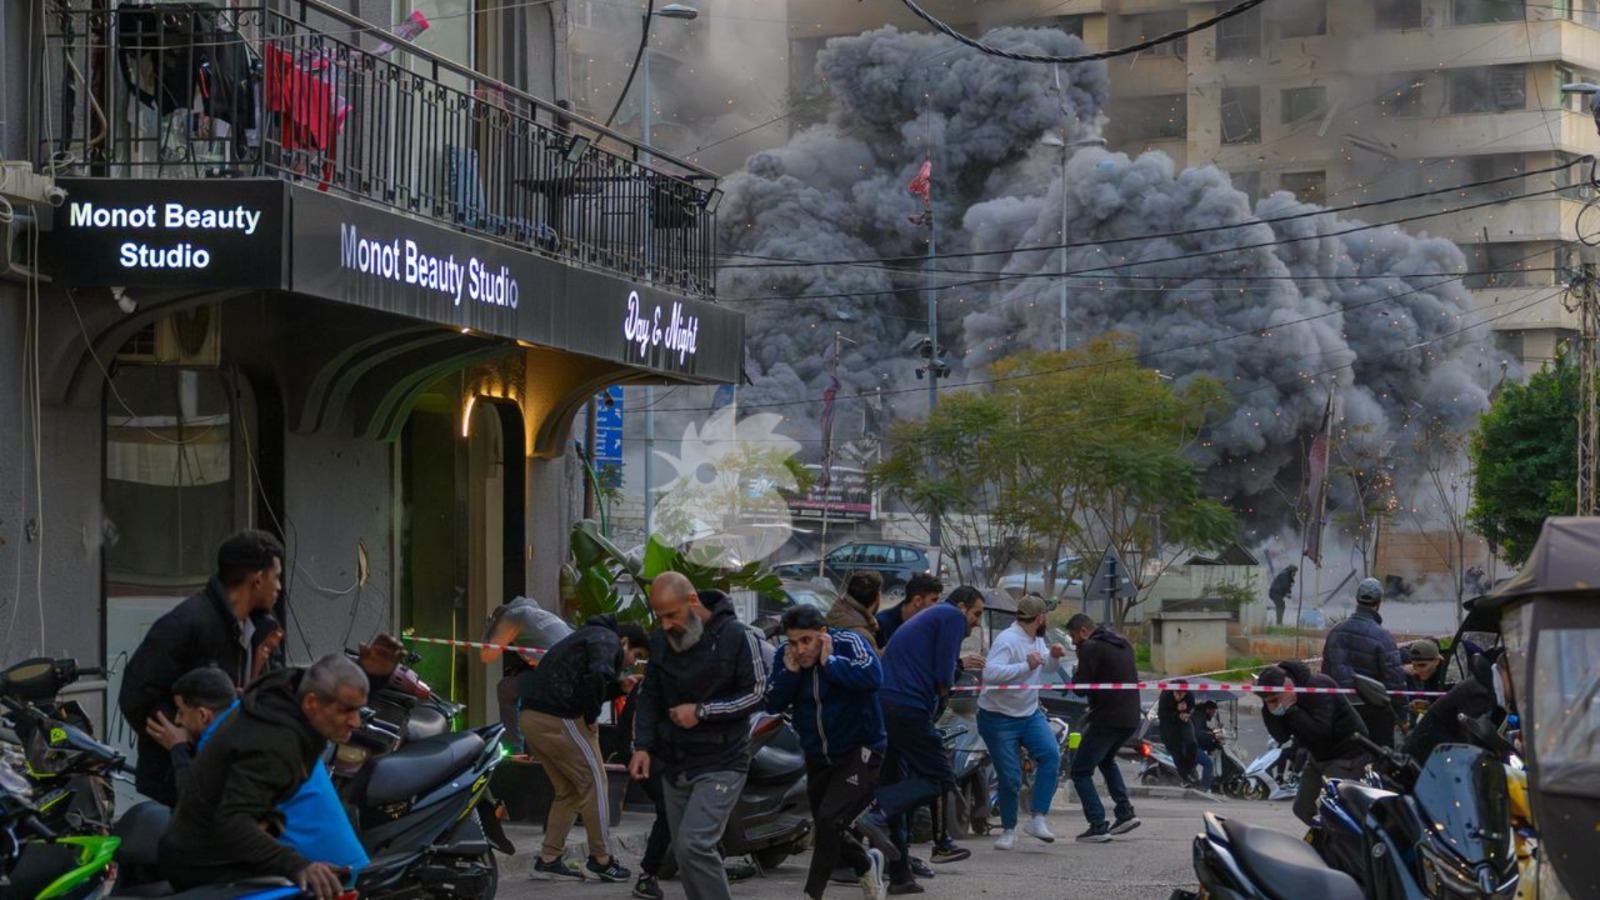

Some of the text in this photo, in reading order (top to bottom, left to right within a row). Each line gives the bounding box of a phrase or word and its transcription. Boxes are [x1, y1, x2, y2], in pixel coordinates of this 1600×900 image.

[69, 202, 262, 235] Monot Beauty
[119, 242, 211, 268] Studio
[340, 222, 519, 309] Monot Beauty Studio
[624, 290, 698, 366] Day & Night
